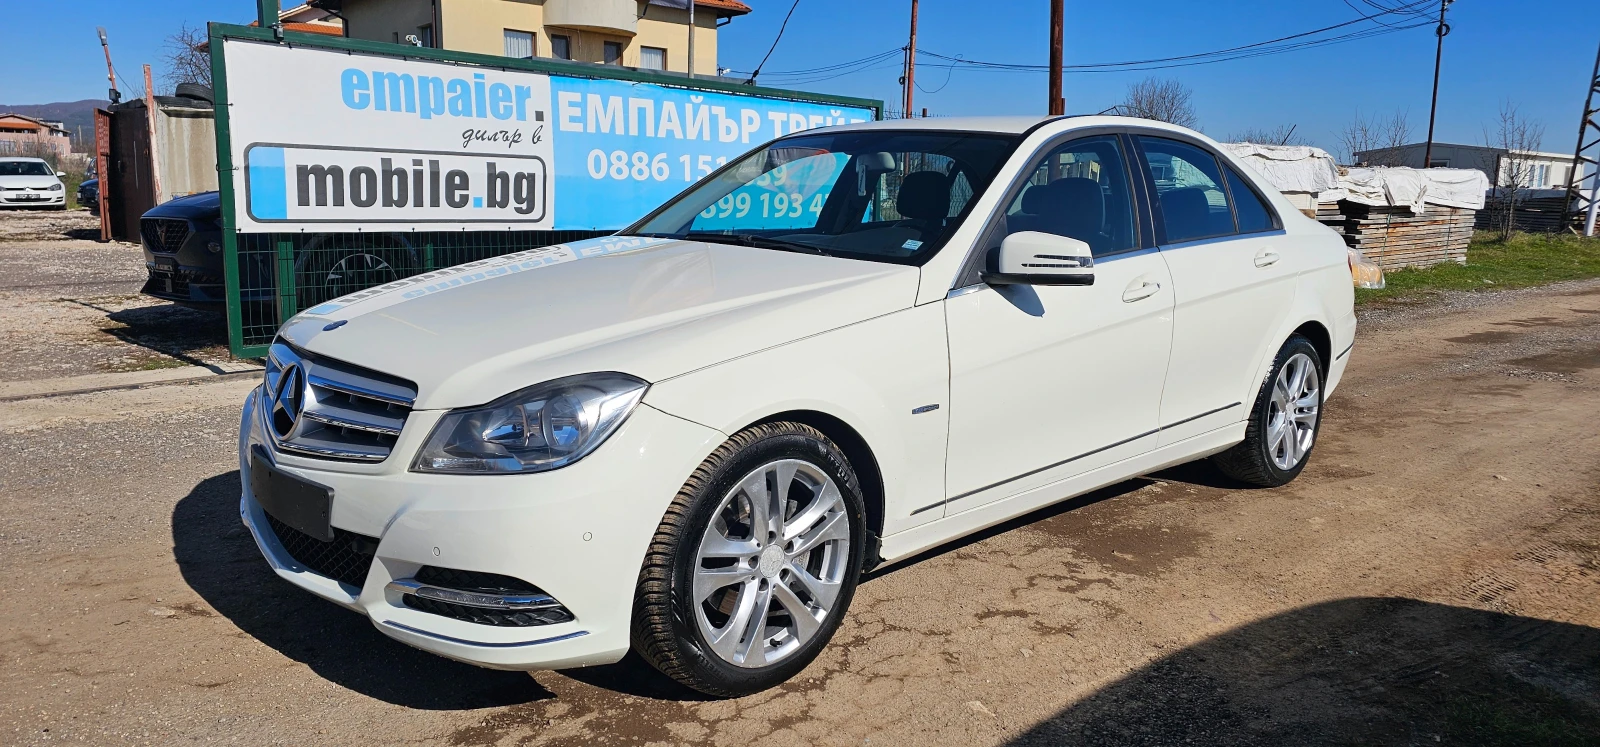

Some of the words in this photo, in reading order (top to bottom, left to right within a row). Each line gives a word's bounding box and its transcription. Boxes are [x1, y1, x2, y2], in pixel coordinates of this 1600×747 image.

[340, 67, 544, 122] empaier.
[461, 128, 523, 148] дилър
[532, 125, 543, 144] в
[557, 91, 761, 144] ЕМПАЙЪР
[296, 157, 536, 215] mobile.bg
[587, 148, 670, 182] 0886
[760, 192, 803, 218] 193
